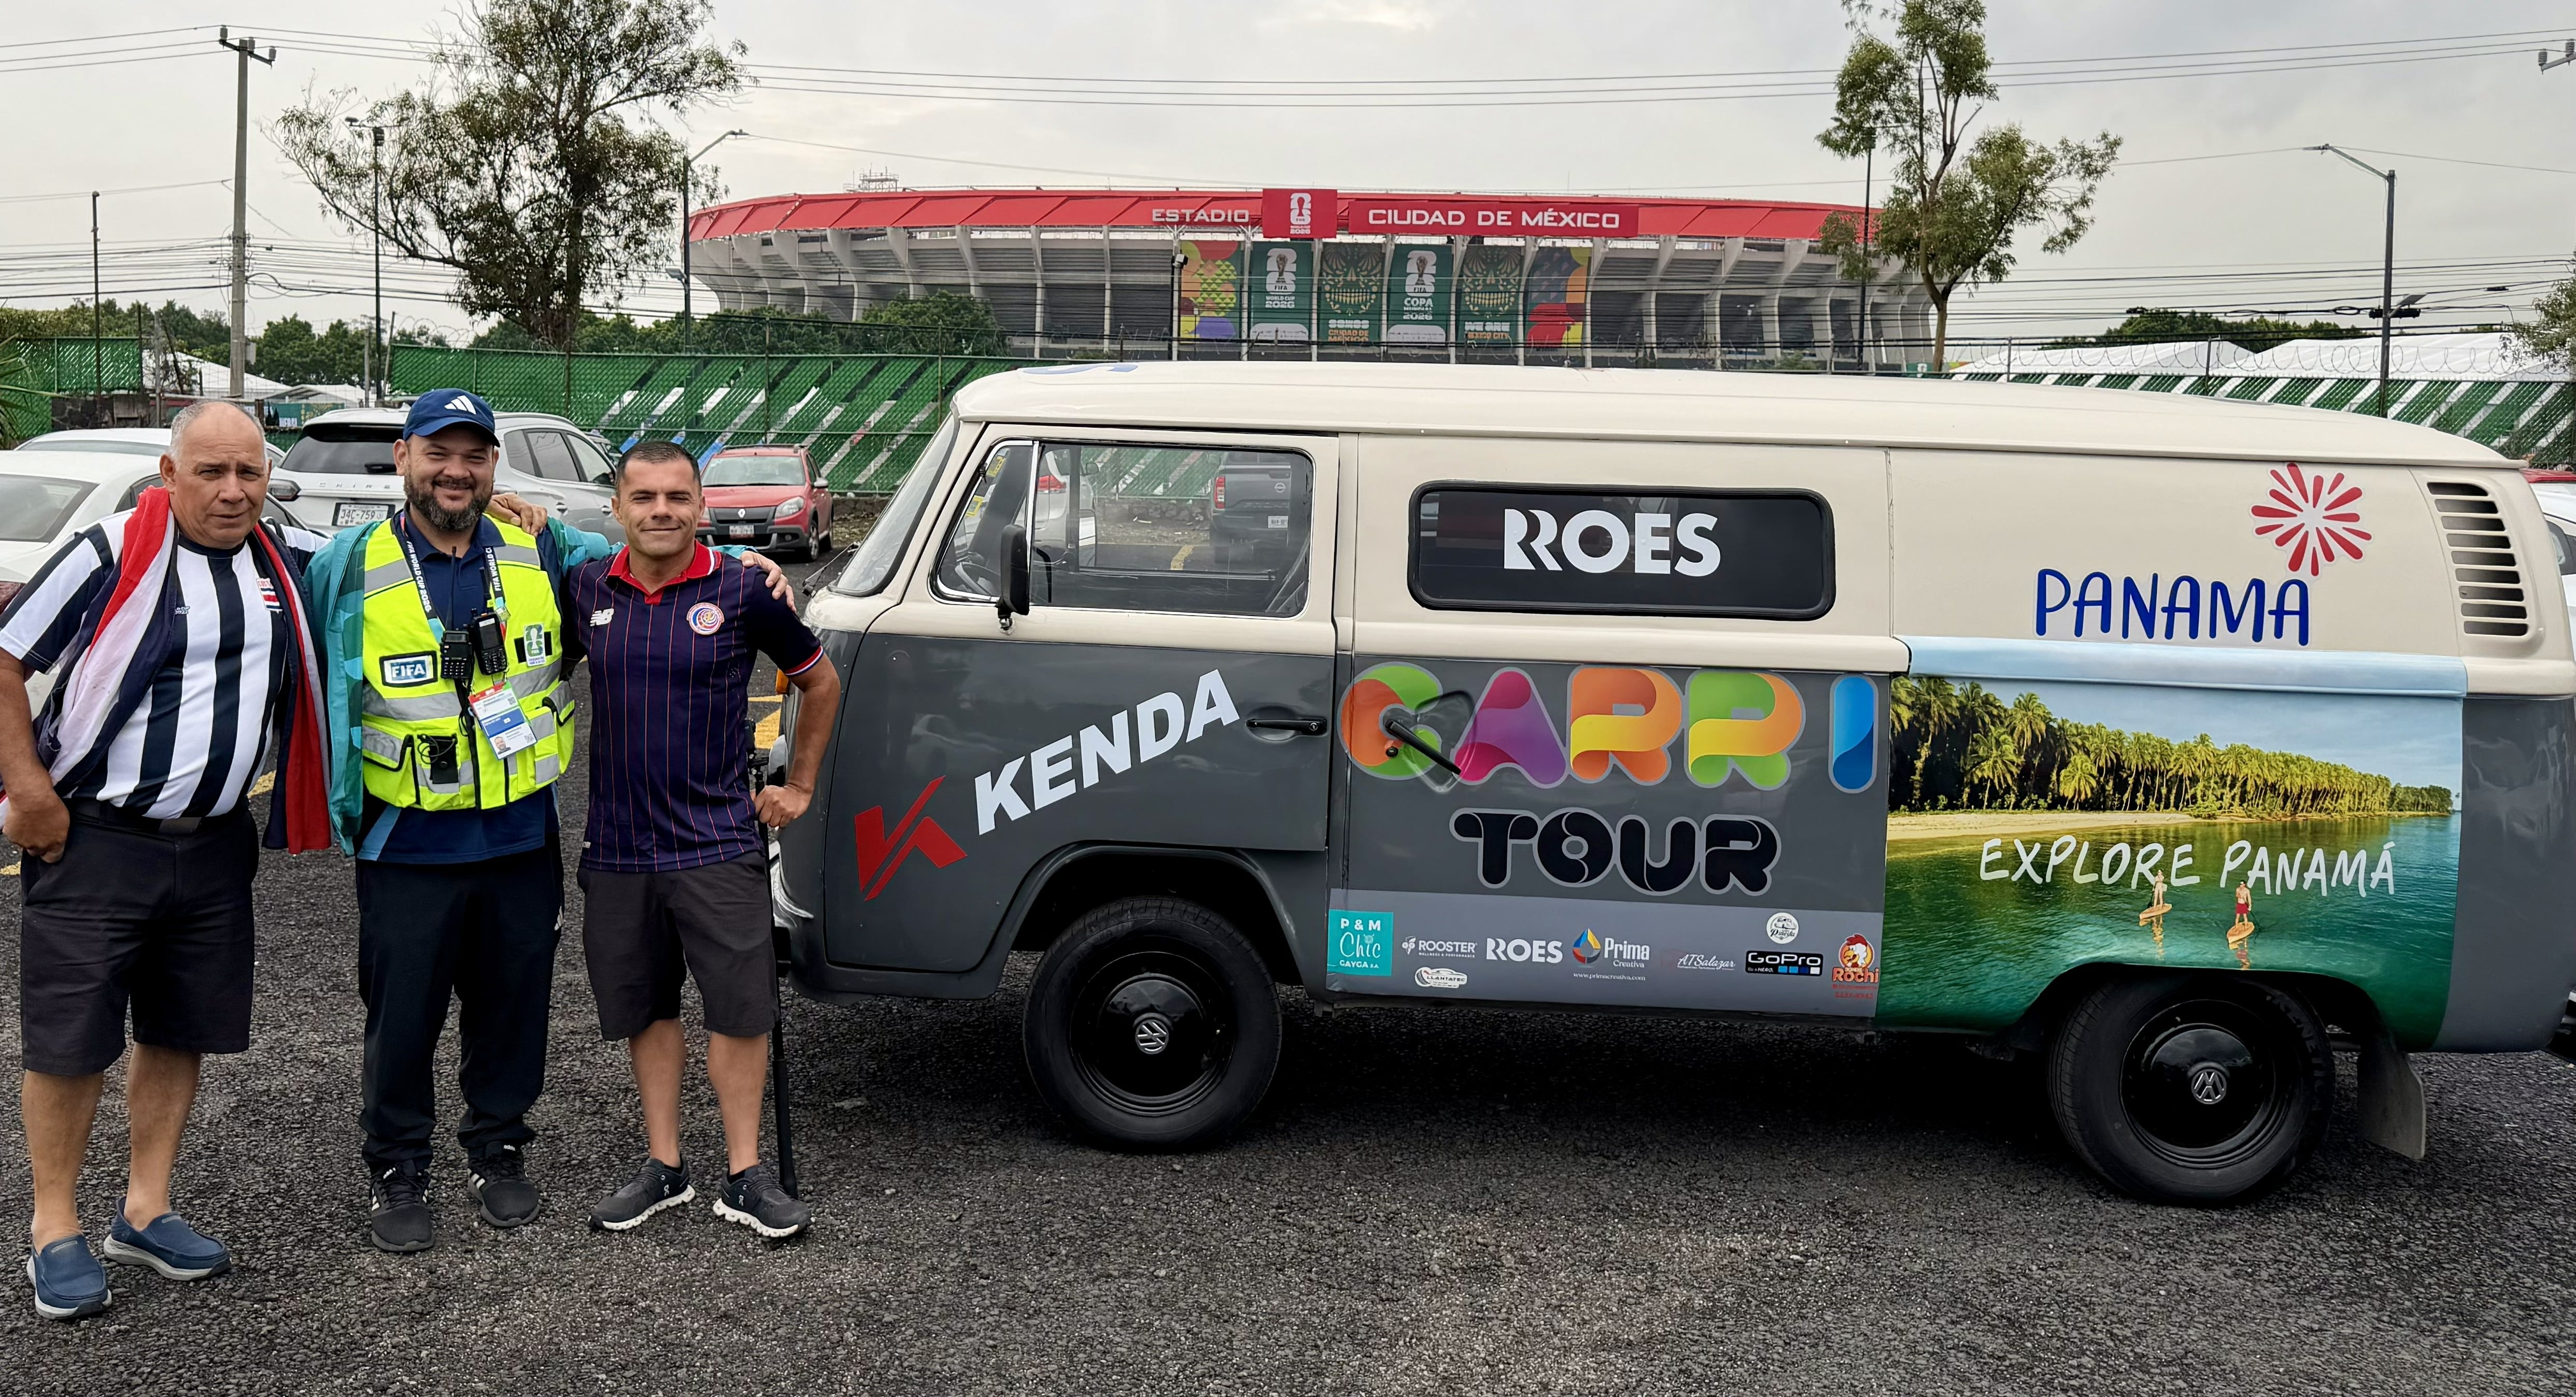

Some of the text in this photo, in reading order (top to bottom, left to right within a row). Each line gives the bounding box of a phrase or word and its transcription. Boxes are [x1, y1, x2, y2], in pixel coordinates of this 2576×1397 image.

[1152, 209, 1249, 222] ESTADIO
[1368, 208, 1620, 228] CIUDAD DE MÉXICO
[1404, 298, 1433, 307] COPA
[410, 553, 421, 576] WORLD
[487, 554, 498, 577] WORLD
[416, 576, 425, 591] CUP
[492, 577, 502, 591] FIFA
[420, 589, 432, 612] 2026
[2036, 568, 2309, 646] PANAMA
[391, 663, 427, 678] FIFA
[974, 669, 1240, 835] KENDA
[1449, 807, 1781, 896] TOUR
[1980, 835, 2395, 897] EXPLORE PANAMÁ
[1340, 918, 1381, 931] P & M
[1340, 932, 1381, 958] Chic
[1419, 940, 1476, 953] ROOSTER
[1604, 937, 1650, 961] Prima
[1613, 960, 1645, 968] Creativa
[1748, 952, 1821, 966] GoPro
[1573, 972, 1646, 981] www.primacreativa.com
[1832, 967, 1879, 983] Rochi
